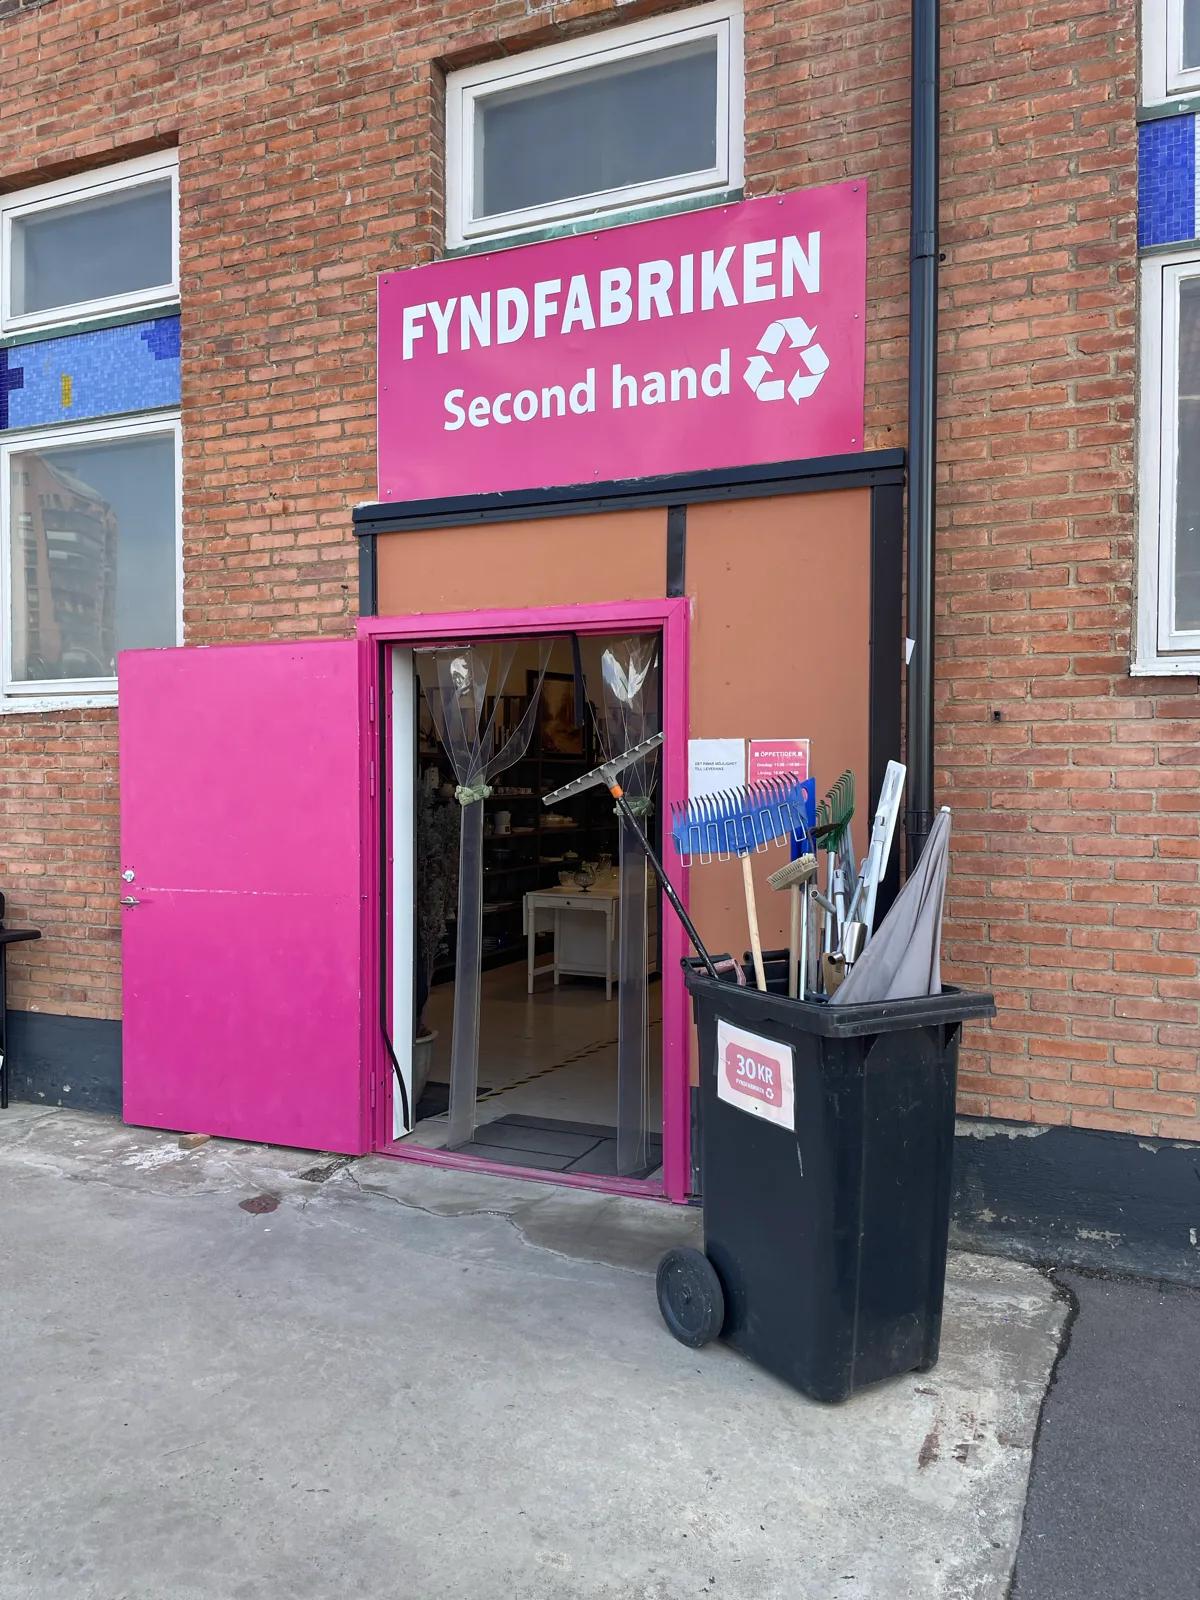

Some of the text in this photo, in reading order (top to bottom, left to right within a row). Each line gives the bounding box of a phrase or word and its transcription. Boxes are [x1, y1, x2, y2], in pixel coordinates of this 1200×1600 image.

[402, 231, 822, 361] FYNDFABRIKEN
[443, 348, 731, 431] Second hand
[736, 1054, 774, 1086] 30 KR
